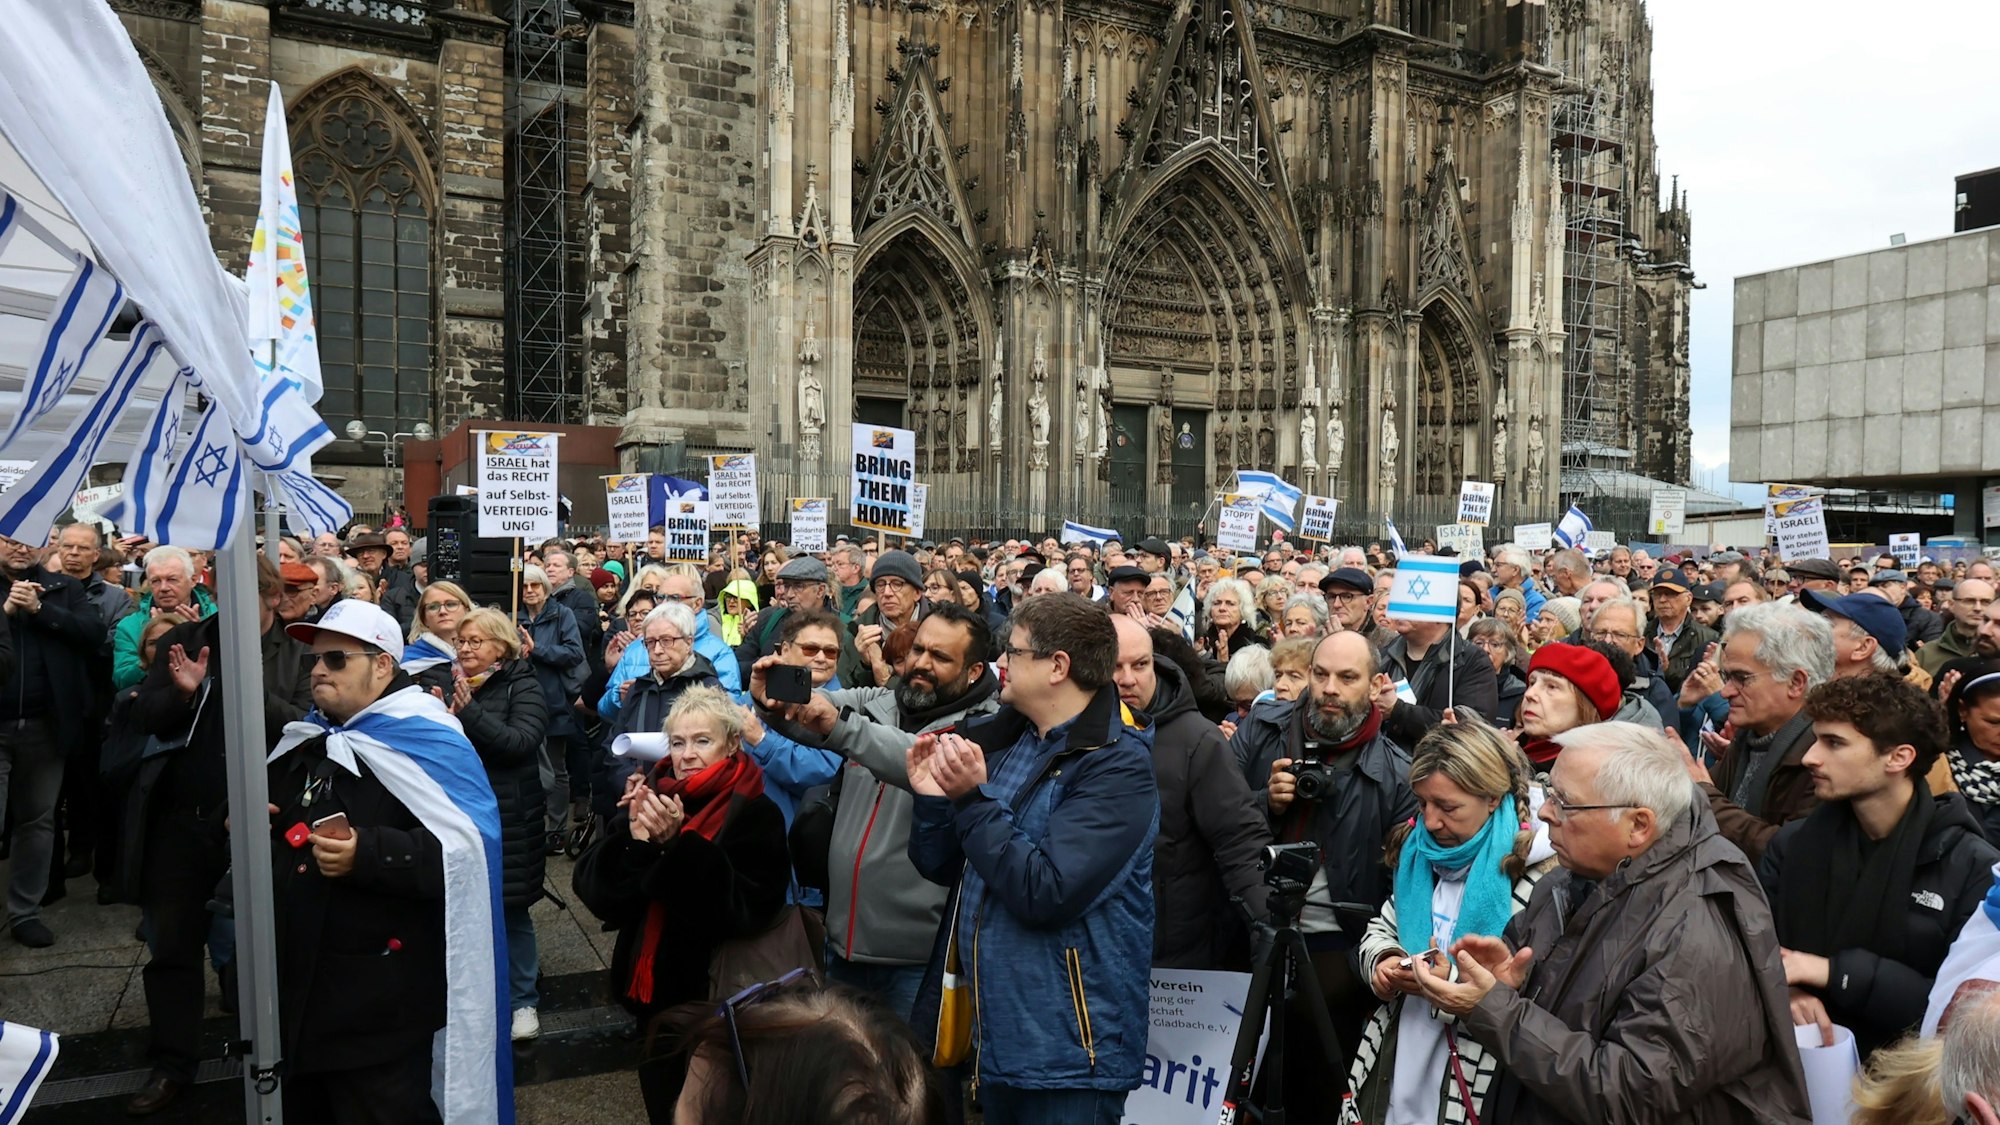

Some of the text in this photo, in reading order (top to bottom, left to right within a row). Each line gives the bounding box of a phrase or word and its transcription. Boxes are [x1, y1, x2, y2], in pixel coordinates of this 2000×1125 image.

[486, 457, 550, 469] ISRAEL hat
[855, 453, 911, 480] BRING
[487, 471, 549, 482] das RECHT
[486, 489, 551, 501] auf Selbst-
[858, 478, 907, 505] THEM
[76, 491, 99, 506] Nein
[611, 495, 643, 506] ISRAEL!
[1462, 493, 1491, 504] BRING
[483, 505, 553, 516] VERTEIDIG-
[1305, 507, 1333, 519] BRING
[1463, 503, 1487, 513] THEM
[623, 511, 645, 519] stehen
[857, 503, 907, 529] HOME
[1224, 510, 1254, 520] STOPPT
[1460, 513, 1487, 523] HOME
[502, 521, 535, 531] UNG!
[668, 517, 707, 531] BRING
[1306, 518, 1330, 529] THEM
[1780, 515, 1819, 529] ISRAEL!
[618, 530, 641, 539] Seite!!!
[1303, 528, 1329, 539] HOME
[1440, 525, 1478, 537] ISRAEL
[1781, 529, 1823, 541] Wir stehen
[670, 532, 704, 546] THEM
[1463, 540, 1480, 549] SND
[1797, 539, 1821, 548] Deiner
[794, 541, 824, 551] Israel
[1892, 544, 1918, 552] BRING
[669, 547, 704, 561] HOME
[1791, 548, 1819, 557] Seite!!!
[1150, 980, 1203, 993] Verein
[1177, 996, 1195, 1005] der
[1154, 1018, 1205, 1030] Gladbach
[1220, 1025, 1230, 1034] V.
